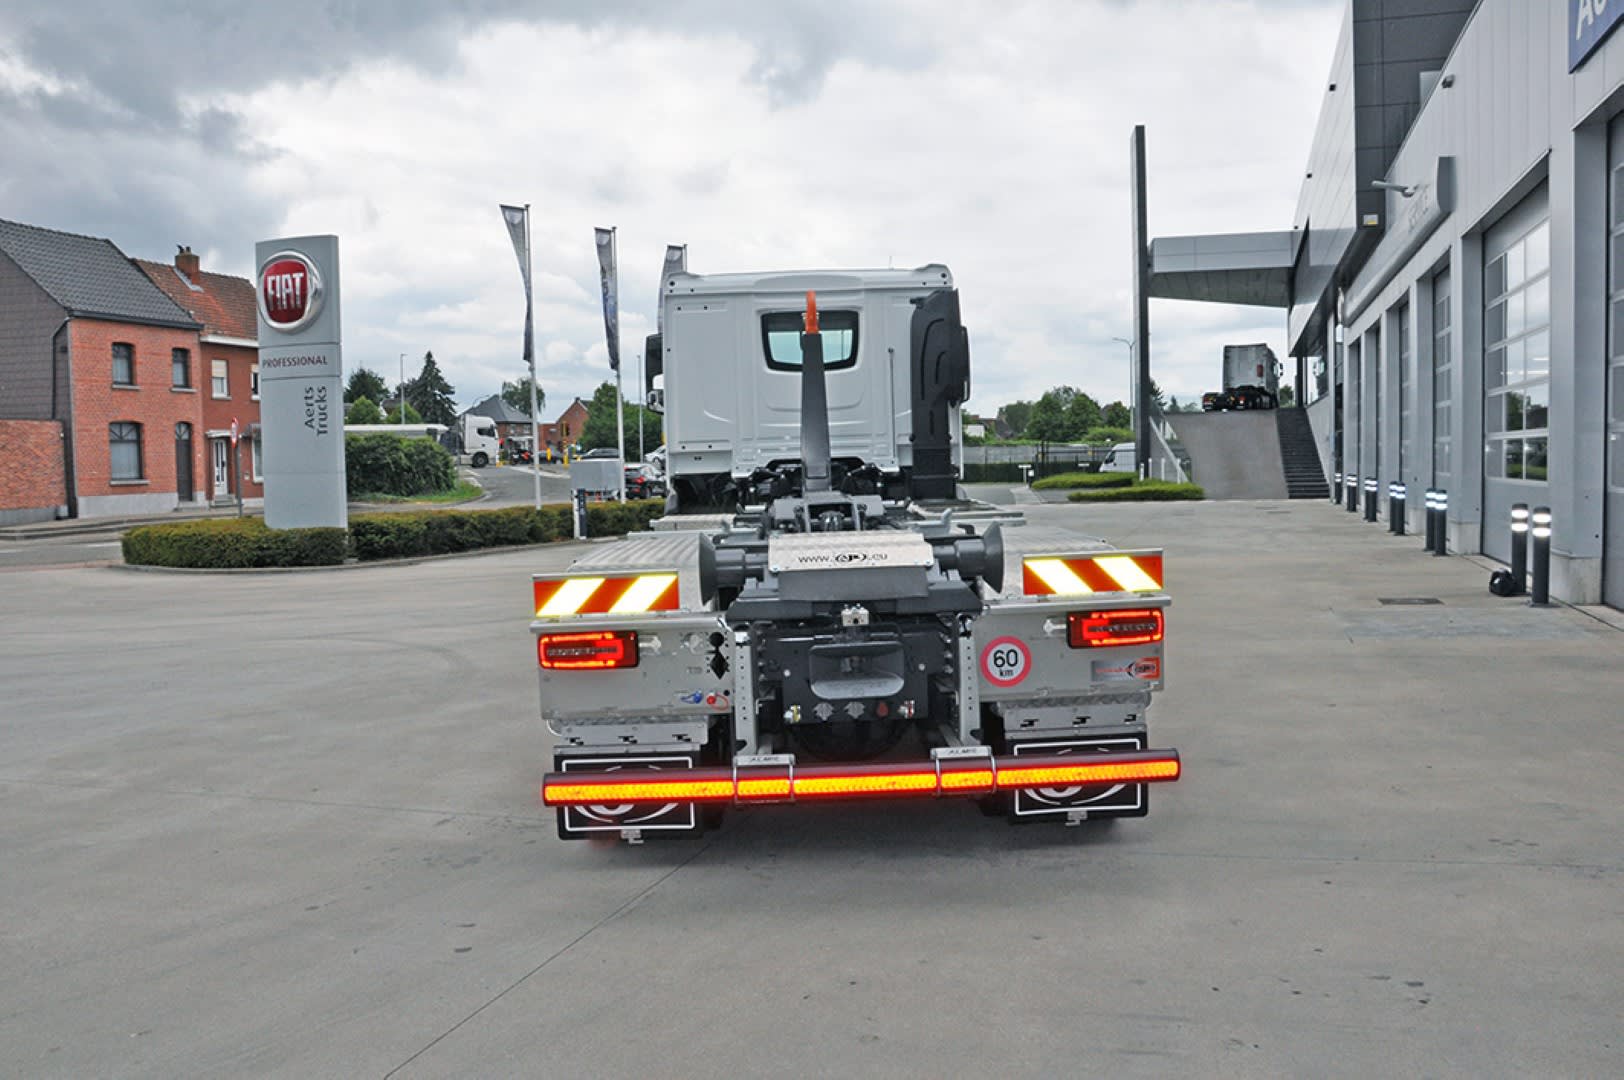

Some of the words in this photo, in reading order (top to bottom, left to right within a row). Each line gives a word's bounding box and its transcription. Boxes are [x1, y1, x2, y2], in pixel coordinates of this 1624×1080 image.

[267, 272, 304, 311] FIAT
[262, 354, 328, 369] PROFESSIONAL
[304, 385, 314, 429] Aerts
[316, 385, 328, 437] Trucks
[993, 649, 1018, 668] 60
[999, 668, 1014, 677] km
